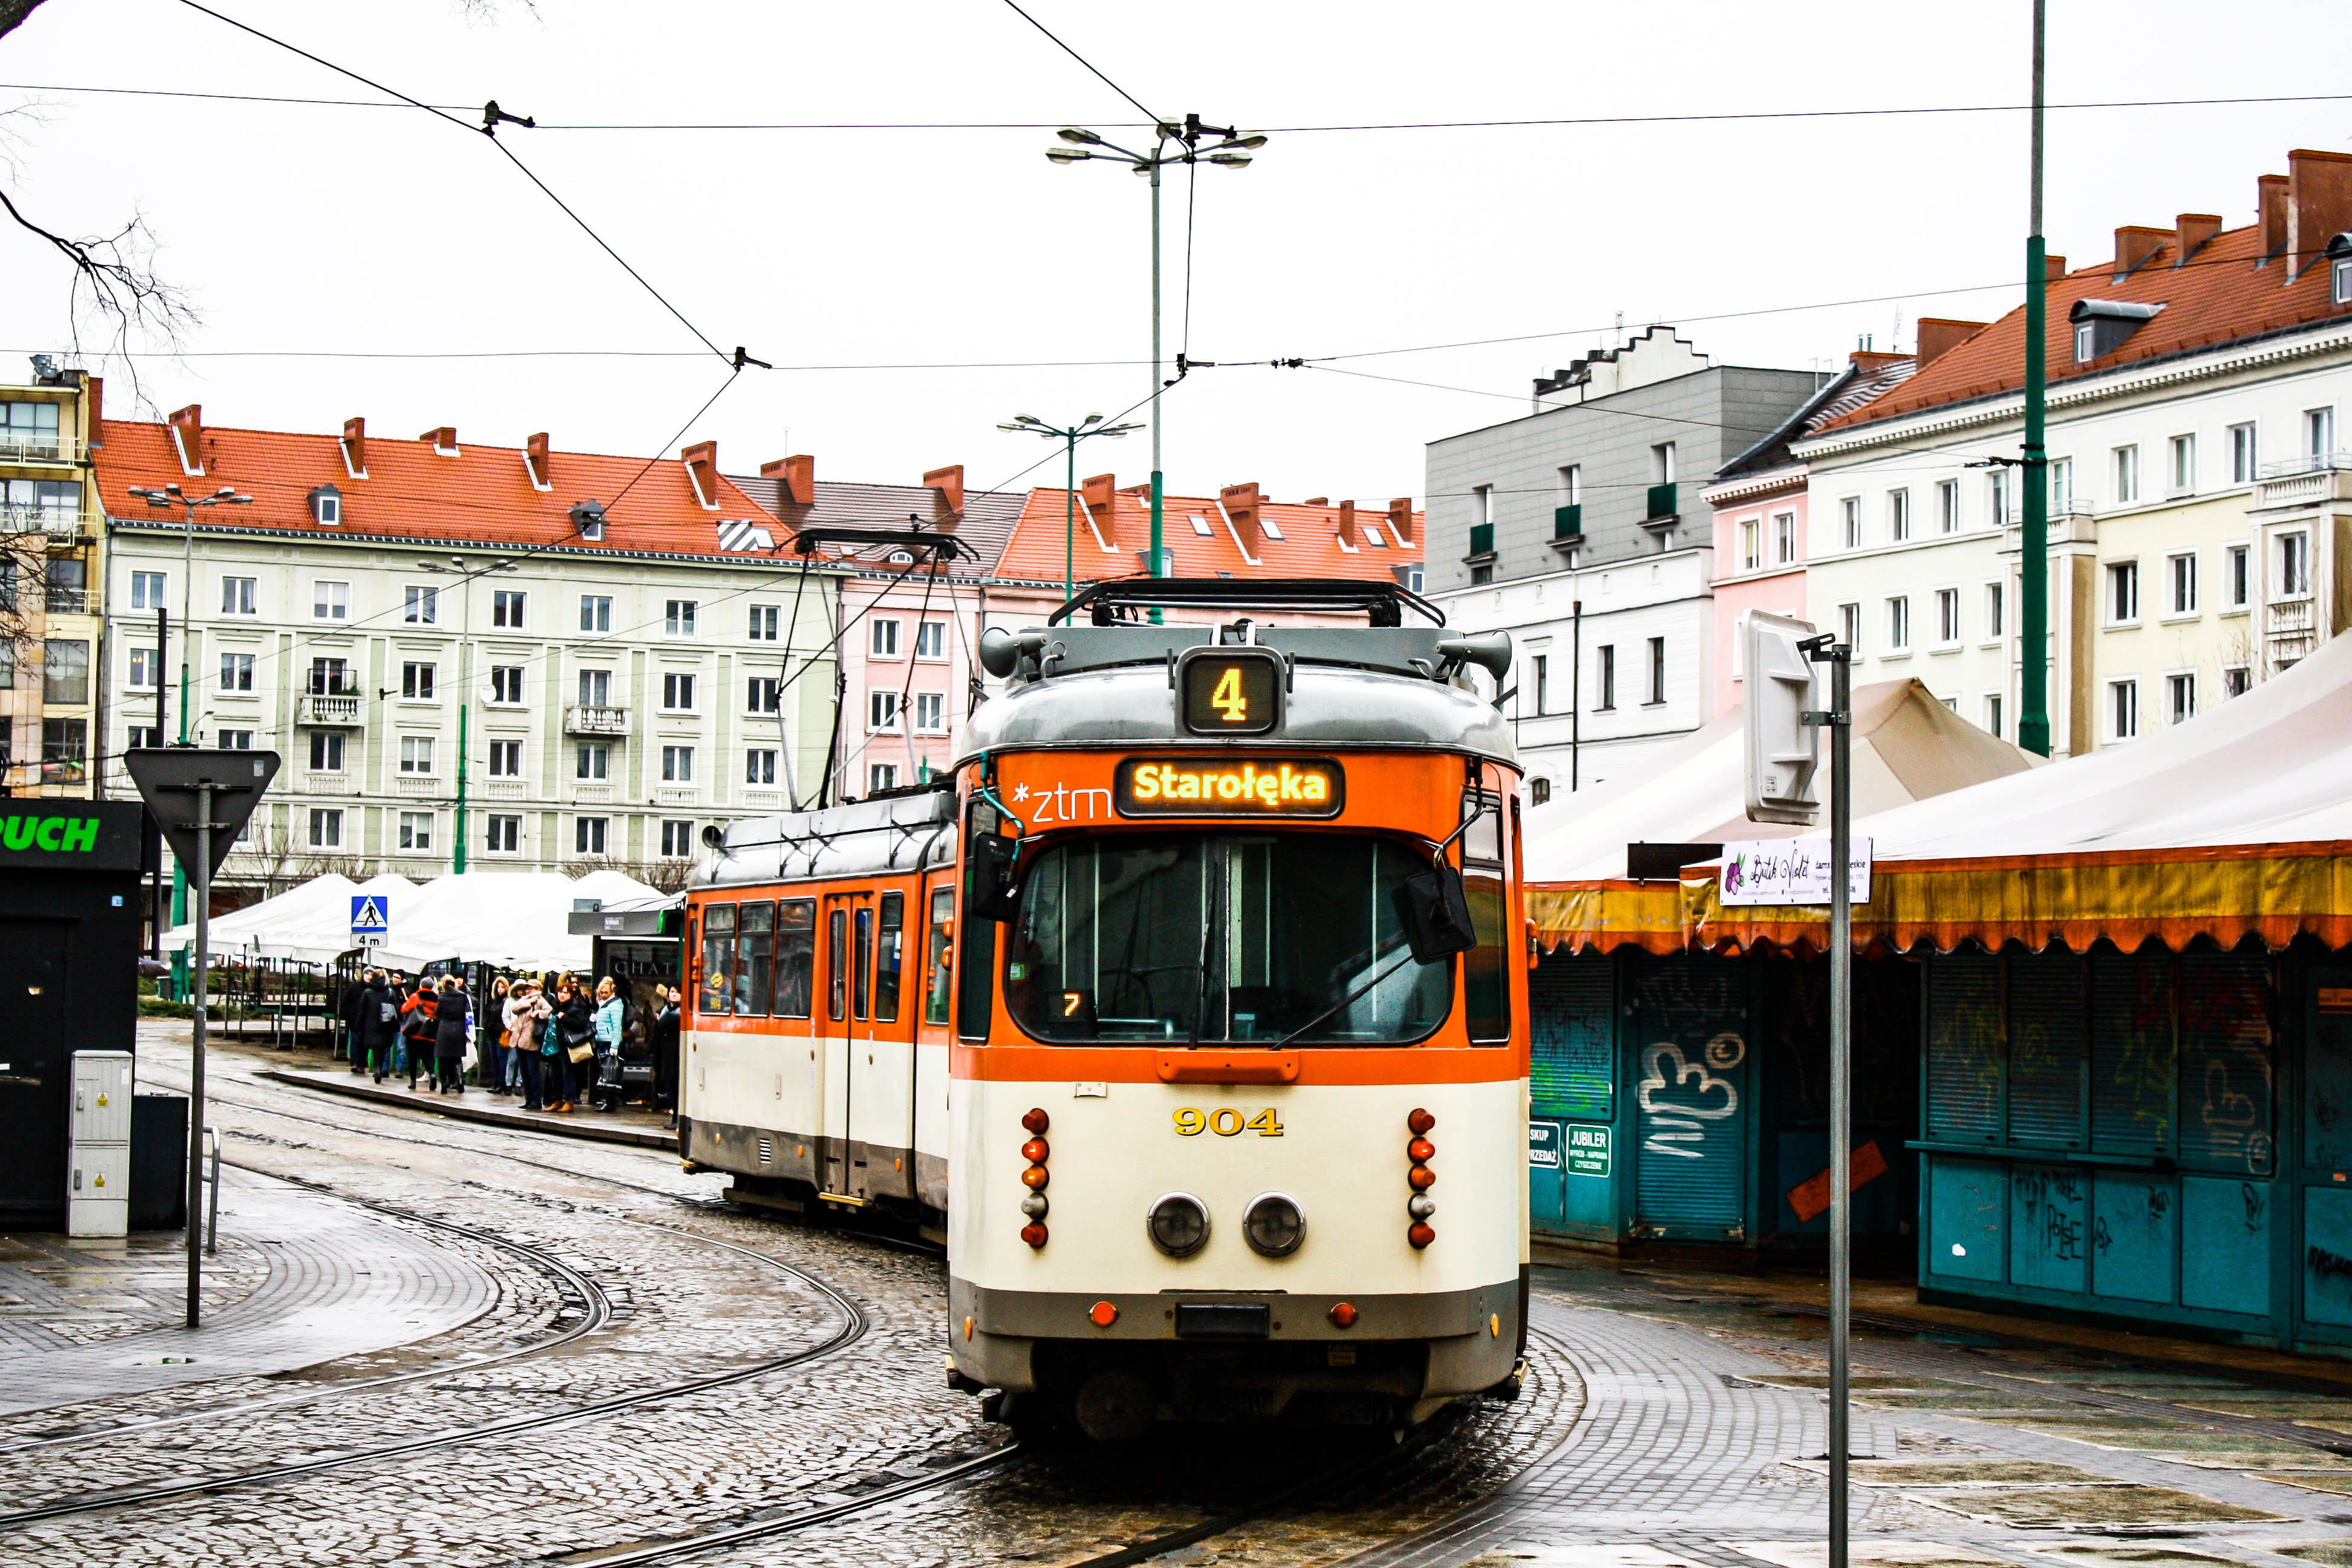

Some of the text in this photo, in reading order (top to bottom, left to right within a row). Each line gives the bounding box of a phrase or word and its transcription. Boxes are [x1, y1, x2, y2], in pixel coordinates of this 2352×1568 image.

[1212, 668, 1246, 721] 4
[1134, 765, 1327, 806] Starołęka
[0, 815, 100, 852] UCH
[359, 935, 366, 946] 4
[615, 961, 674, 975] CHAT
[1064, 993, 1079, 1016] 7
[1172, 1108, 1284, 1137] 904
[1529, 1129, 1549, 1142] SKUP
[1571, 1131, 1606, 1148] JUBILER
[1529, 1148, 1557, 1163] RZEDAŻ
